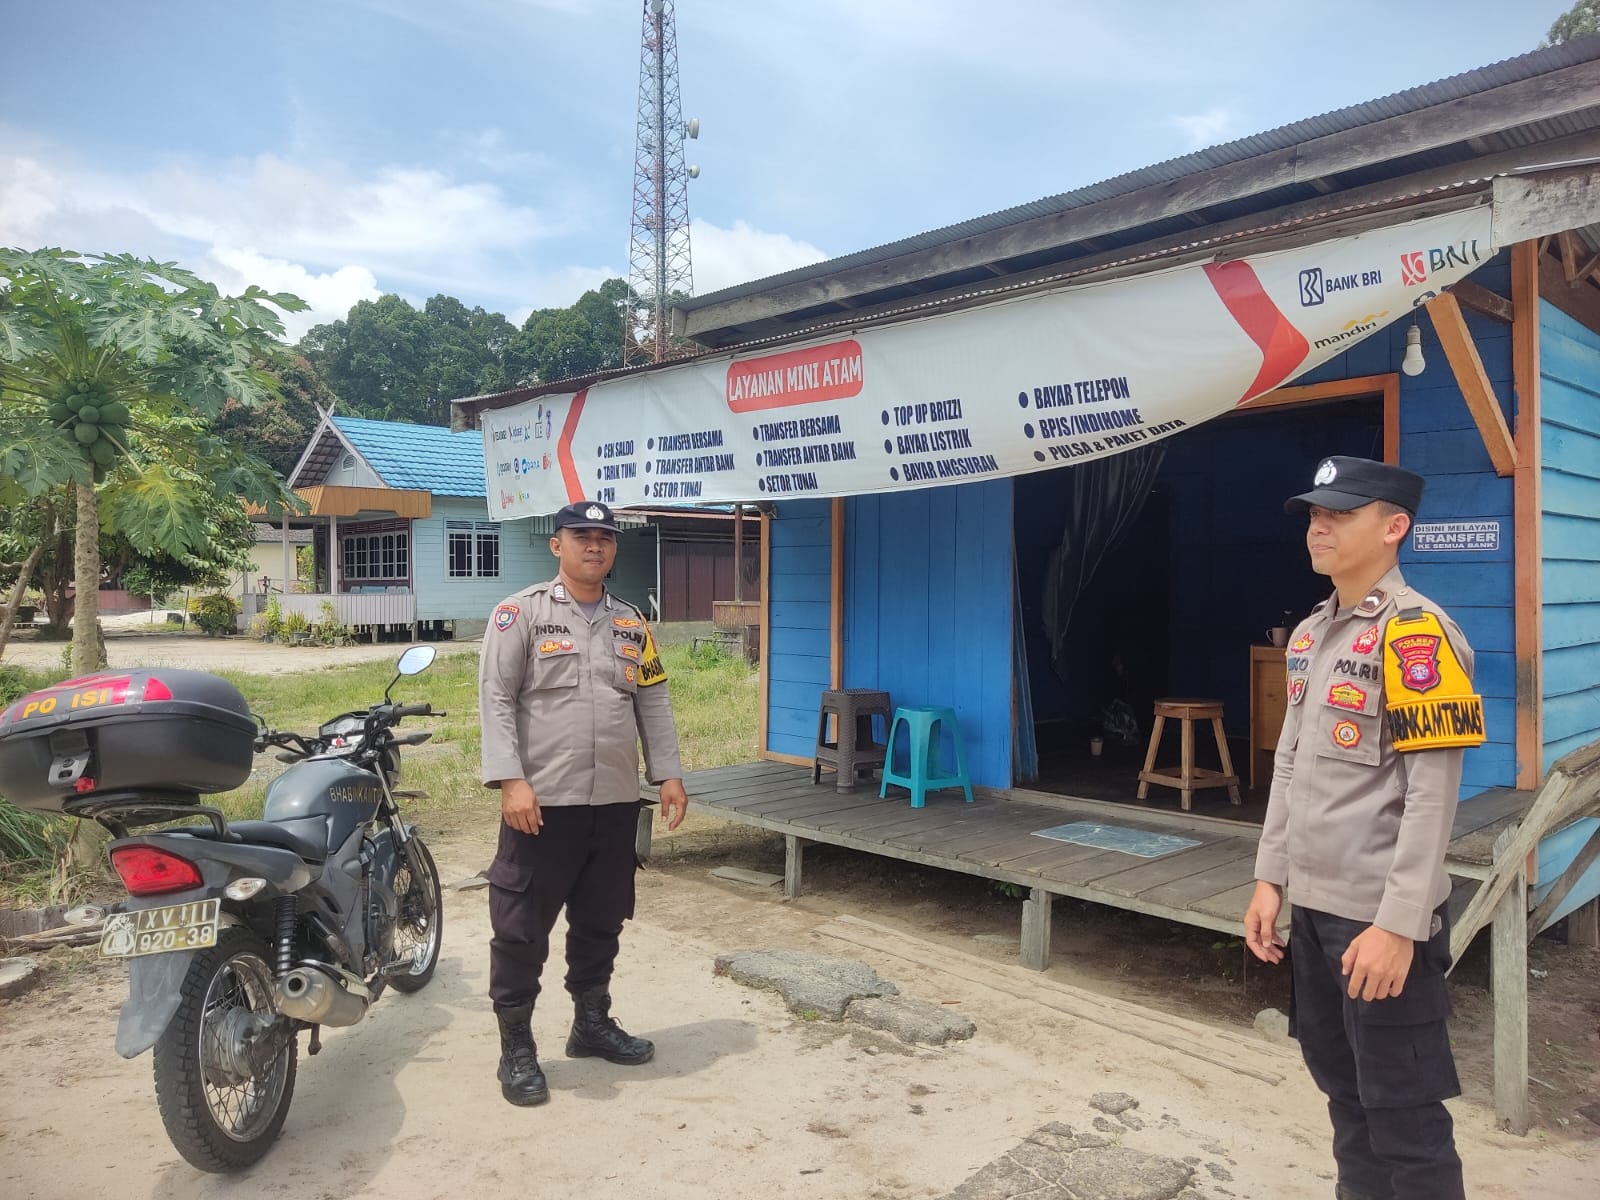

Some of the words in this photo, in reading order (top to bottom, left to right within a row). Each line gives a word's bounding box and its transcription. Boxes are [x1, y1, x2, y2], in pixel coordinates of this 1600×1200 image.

[1428, 239, 1480, 273] BNI
[1326, 273, 1359, 293] BANK
[1362, 270, 1382, 286] BRI
[1314, 320, 1377, 350] mandiri
[728, 369, 783, 401] LAYANAN
[787, 362, 819, 392] MINI
[822, 355, 862, 387] ATAM
[1033, 383, 1074, 409] BAYAR
[1074, 377, 1130, 404] TELEPON
[894, 405, 913, 426] TOP
[915, 403, 928, 424] UP
[929, 399, 962, 422] BRIZZI
[658, 434, 691, 451] TRANSFER
[690, 429, 723, 449] BERSAMA
[759, 421, 799, 442] TRANSFER
[799, 415, 841, 439] BERSAMA
[1048, 442, 1094, 461] PULSA
[1093, 441, 1105, 452] &
[1103, 429, 1148, 449] PAKET
[1147, 419, 1187, 437] DATA
[603, 443, 615, 458] CEK
[615, 440, 634, 457] SALDO
[897, 433, 930, 455] BAYAR
[929, 428, 972, 451] LISTRIK
[655, 457, 693, 475] TRANSFER
[694, 456, 716, 473] ANTAR
[715, 453, 735, 471] BANK
[763, 446, 802, 467] TRANSFER
[802, 444, 832, 464] ANTAR
[832, 441, 856, 461] BANK
[603, 465, 620, 481] TARIK
[620, 462, 637, 479] TUNAI
[902, 461, 938, 481] BAYAR
[936, 455, 999, 478] ANGSURAN
[652, 482, 678, 498] SETOR
[679, 481, 702, 498] TUNAI
[766, 475, 791, 493] SETOR
[791, 472, 818, 491] TUNAI
[1415, 525, 1445, 533] DISINI
[1447, 523, 1498, 532] MELAYANI
[1416, 532, 1496, 543] TRANSFER
[535, 624, 570, 636] INDRA
[1334, 658, 1379, 680] POLRI
[140, 926, 213, 951] 920-38
